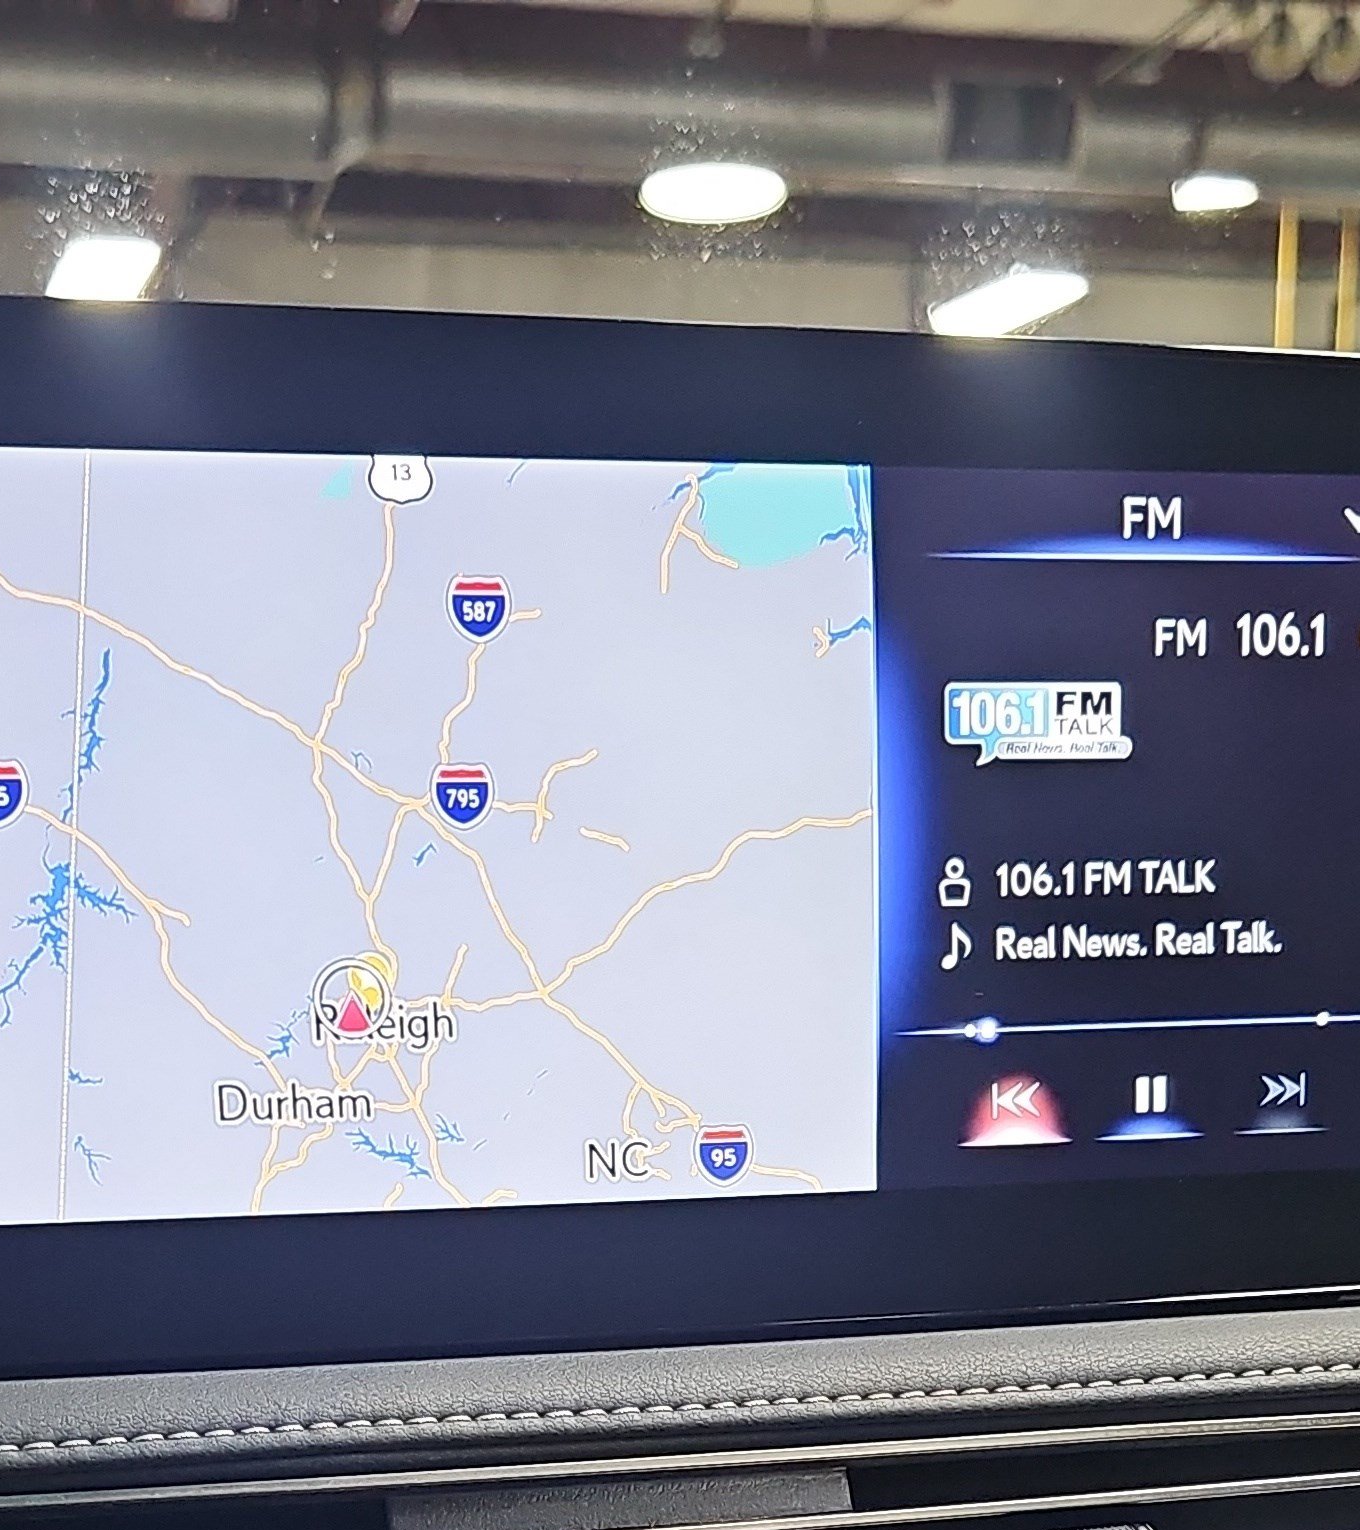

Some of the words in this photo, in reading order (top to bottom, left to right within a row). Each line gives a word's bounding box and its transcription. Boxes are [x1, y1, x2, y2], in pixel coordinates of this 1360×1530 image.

[392, 463, 411, 481] 13
[1122, 496, 1182, 540] FM
[462, 600, 496, 622] 587
[1154, 617, 1207, 657] FM
[1236, 611, 1324, 657] 106.1
[952, 690, 1045, 736] 106.1
[1056, 691, 1112, 715] FM
[1054, 718, 1113, 735] TALK
[446, 788, 480, 809] 795
[995, 861, 1075, 898] 106.1
[1084, 860, 1132, 896] FM
[1138, 858, 1216, 894] TALK
[995, 924, 1057, 960] Real
[1062, 924, 1148, 959] News.
[1155, 920, 1215, 957] Real
[1220, 919, 1283, 954] Talk.
[315, 1002, 455, 1049] Reigh
[218, 1083, 372, 1122] Durham
[588, 1141, 648, 1179] NC
[710, 1147, 737, 1168] 95
